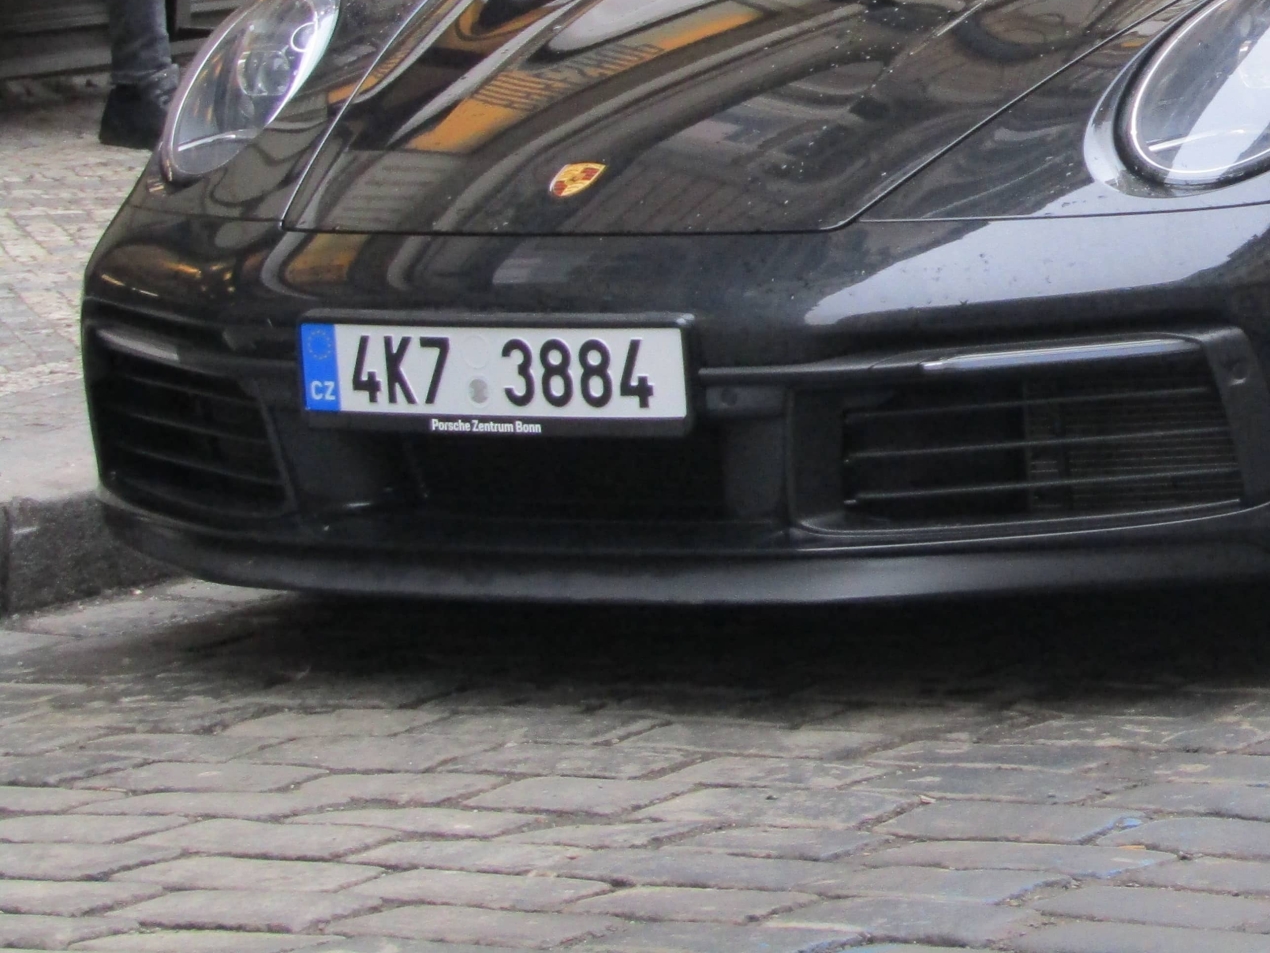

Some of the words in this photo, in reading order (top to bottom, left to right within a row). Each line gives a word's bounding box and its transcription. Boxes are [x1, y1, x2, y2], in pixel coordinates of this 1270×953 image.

[353, 334, 450, 404] 4K7
[501, 337, 655, 409] 3884
[309, 379, 337, 401] CZ
[431, 418, 471, 432] Porsche
[471, 419, 514, 432] Zentrum
[515, 420, 542, 433] Bonn
